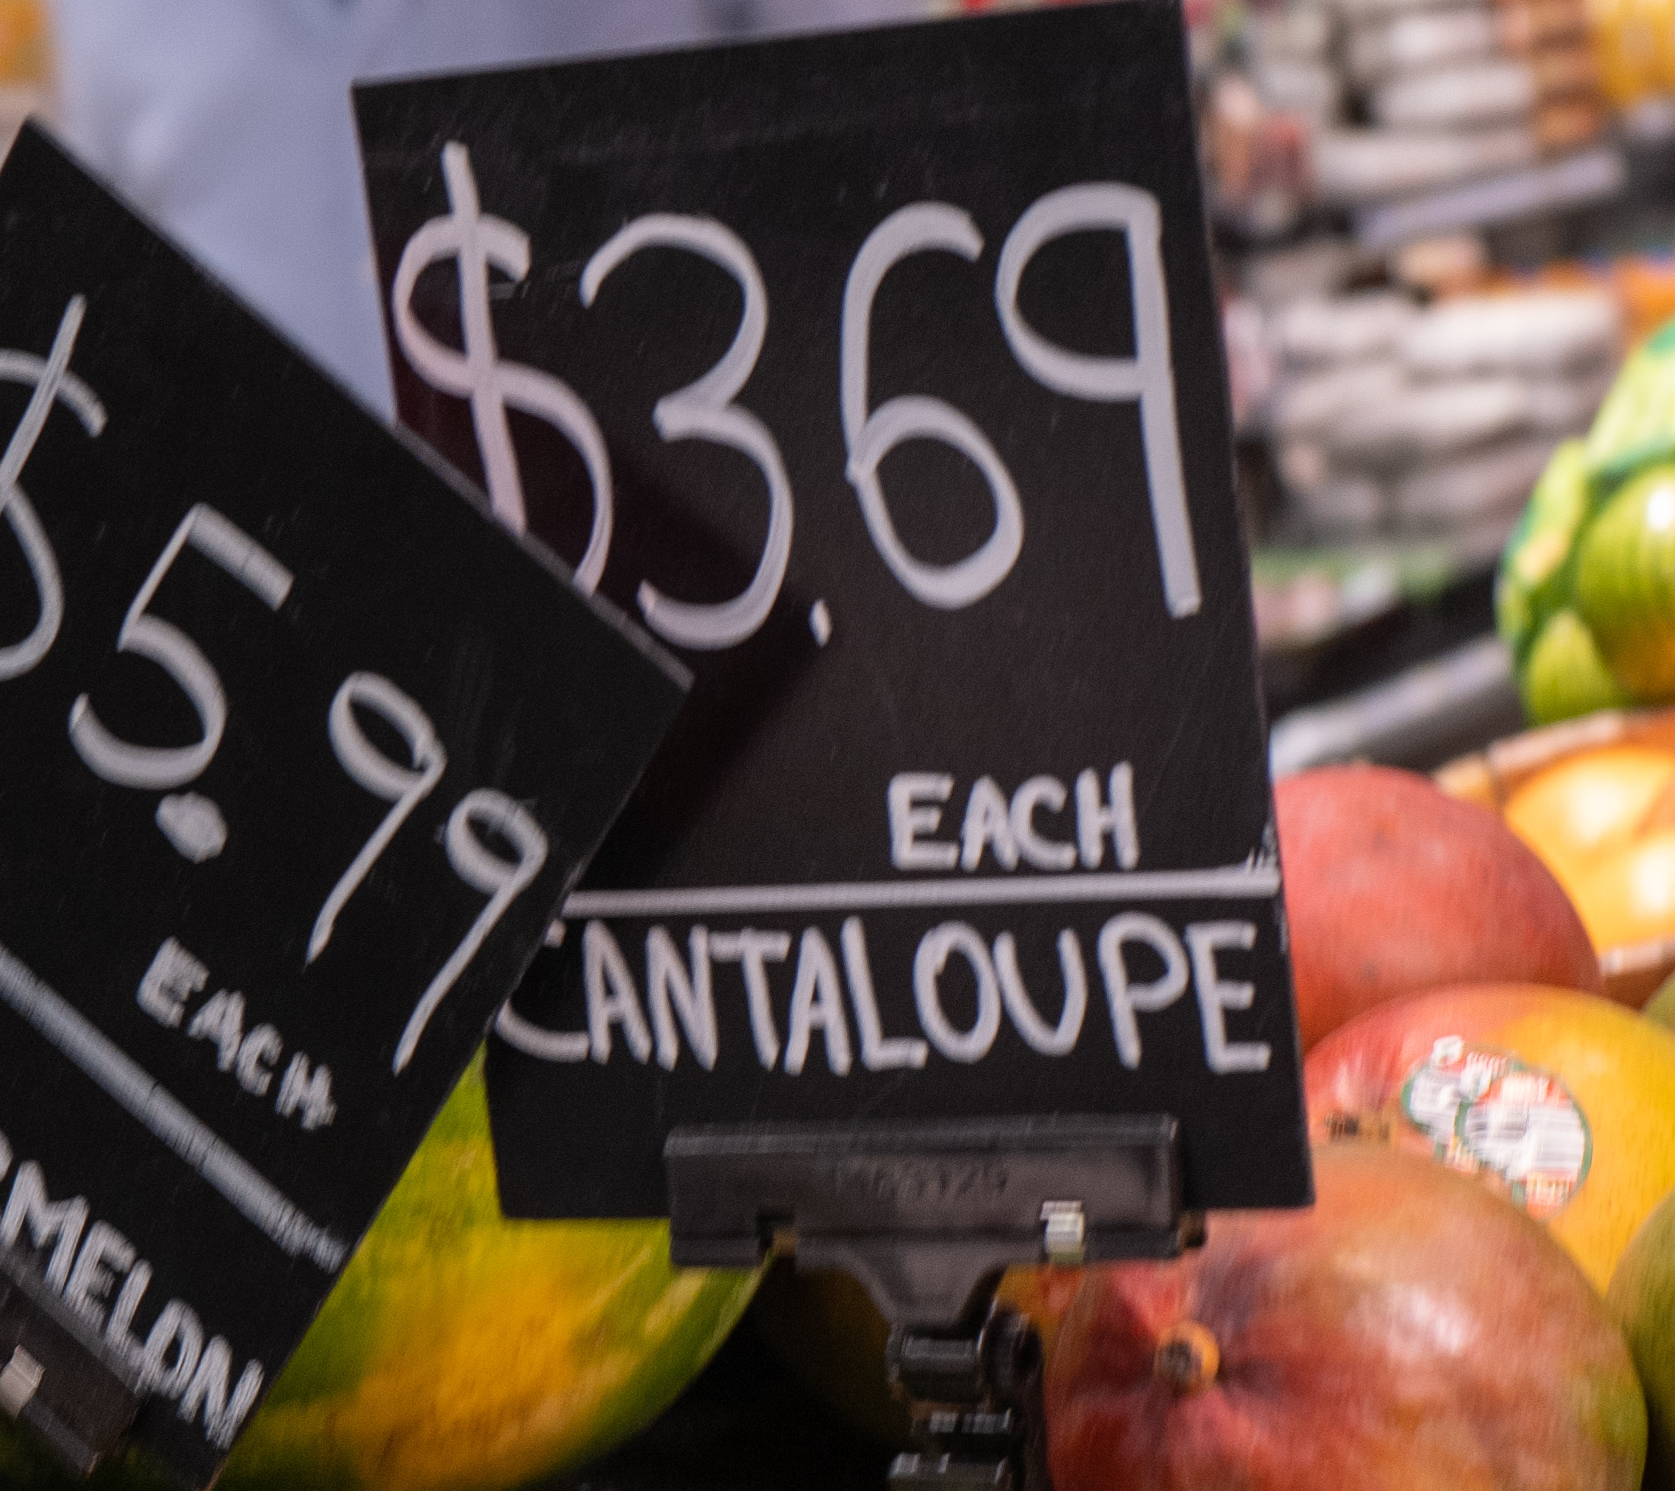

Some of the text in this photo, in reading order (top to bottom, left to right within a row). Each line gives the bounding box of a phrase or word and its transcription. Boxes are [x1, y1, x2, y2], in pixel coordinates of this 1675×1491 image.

[393, 142, 1201, 650] $3.69
[888, 763, 1138, 870] EACH
[137, 937, 335, 1129] EACH
